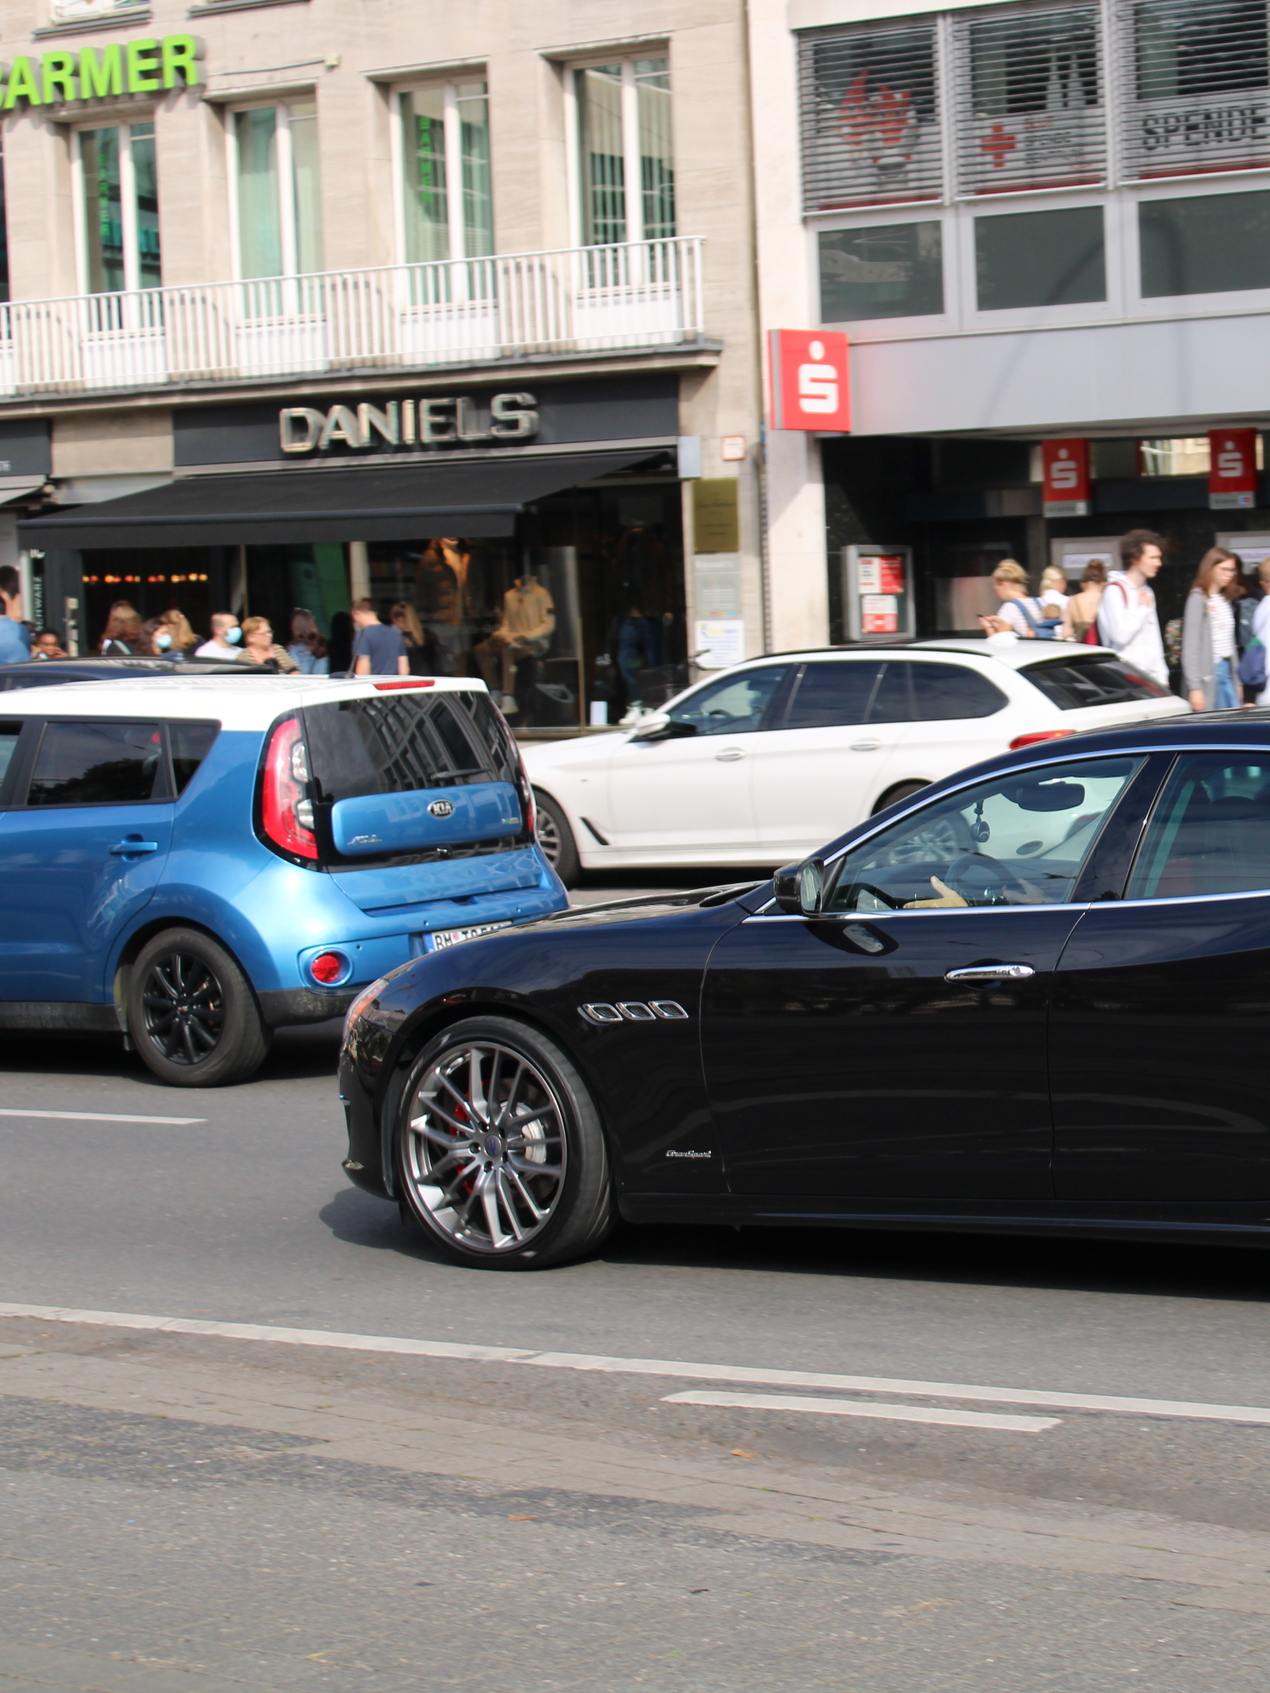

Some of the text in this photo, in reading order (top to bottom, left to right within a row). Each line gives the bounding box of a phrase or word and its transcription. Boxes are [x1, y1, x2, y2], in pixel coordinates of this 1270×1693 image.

[0, 34, 199, 109] ARMER
[1142, 107, 1266, 150] SPENDE
[280, 392, 539, 452] DANIELS
